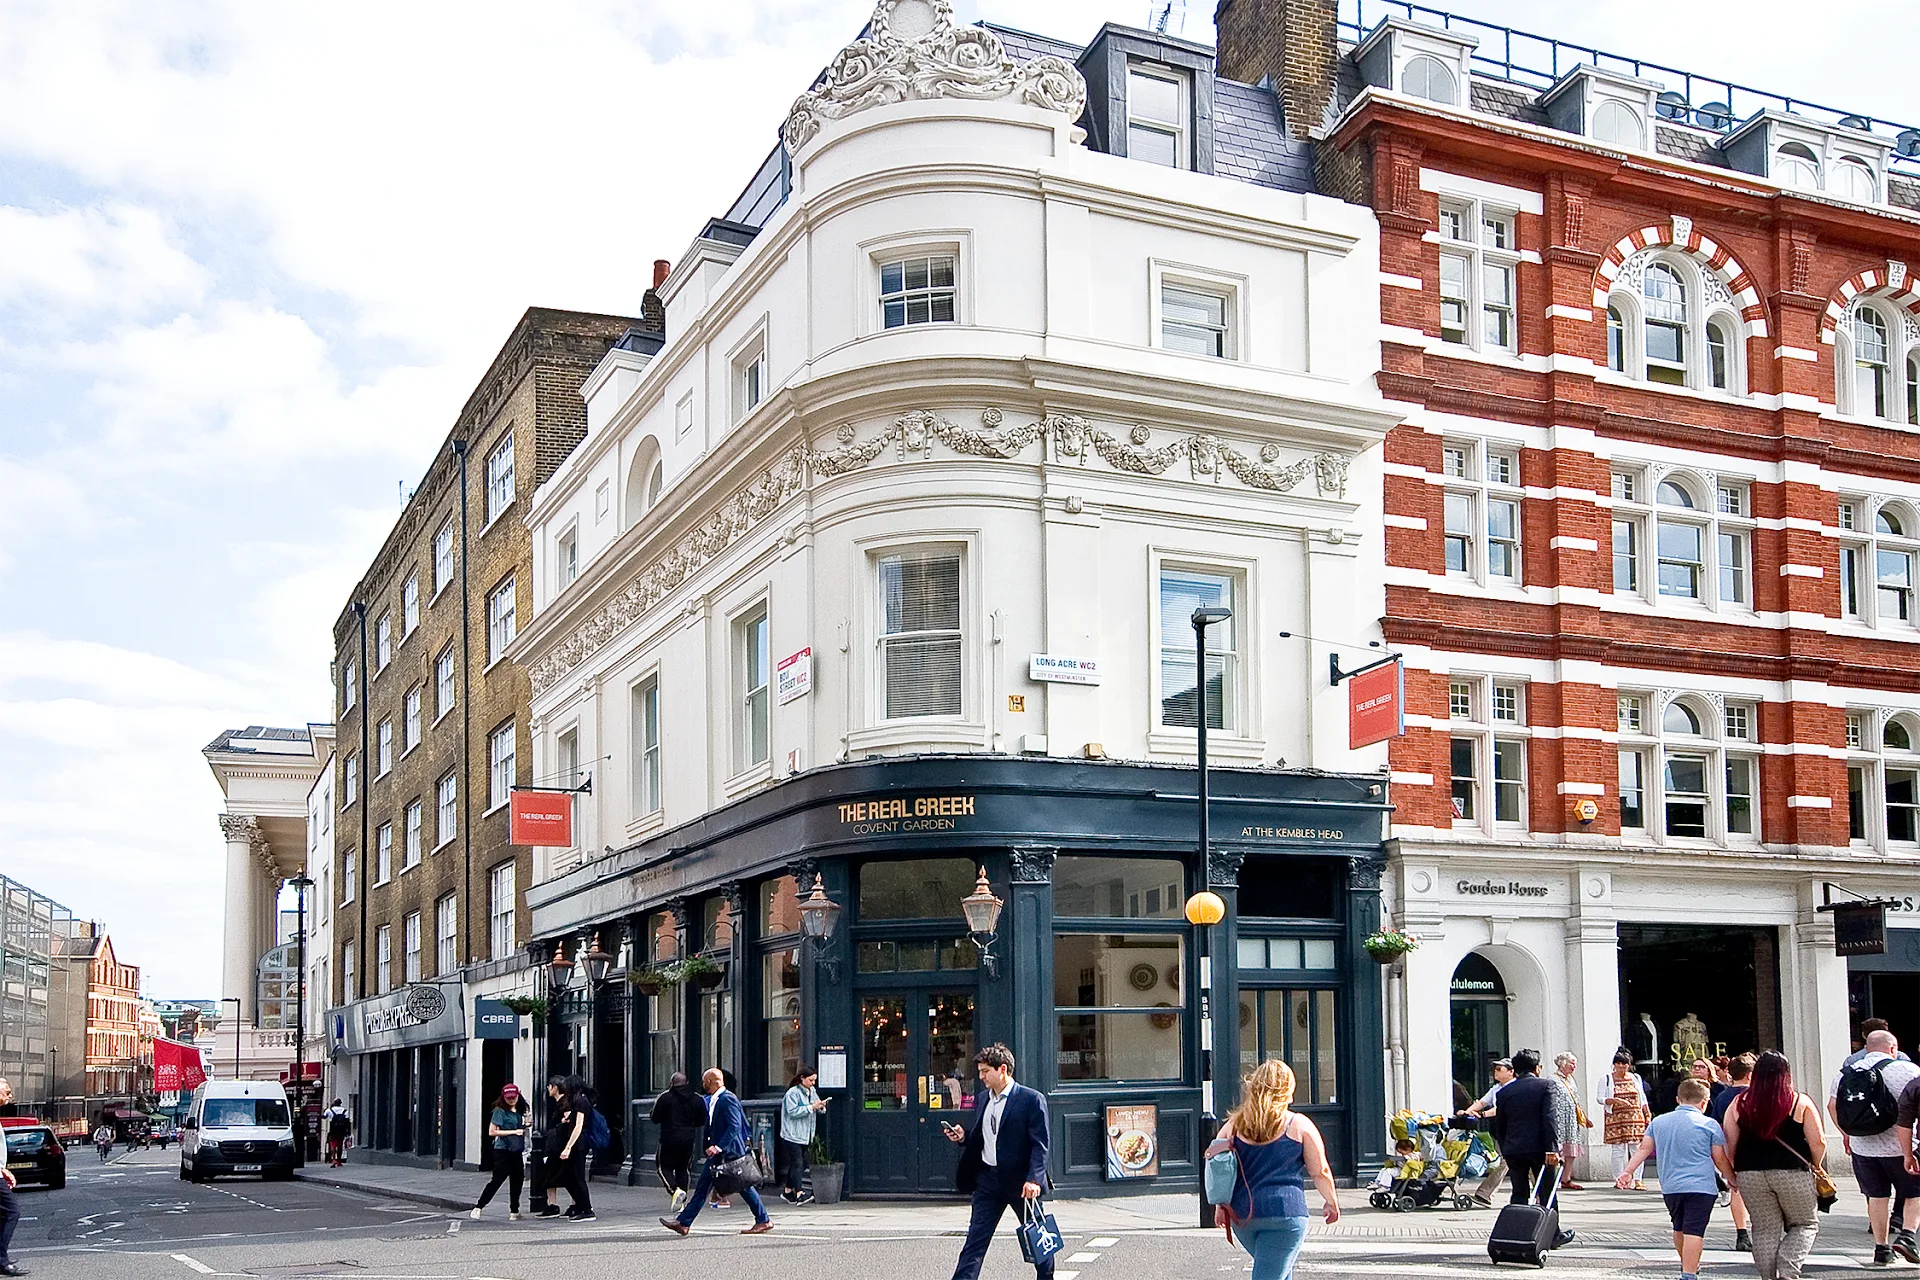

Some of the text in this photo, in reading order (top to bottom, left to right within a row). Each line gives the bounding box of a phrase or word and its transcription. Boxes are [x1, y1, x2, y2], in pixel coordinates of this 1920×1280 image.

[1036, 657, 1096, 670] LONG ACRE WC2
[838, 796, 975, 823] THE REAL GREEK
[852, 818, 956, 835] COVENT GARDEN
[1241, 827, 1343, 840] AT THE KEMBLES HEAD
[1457, 880, 1549, 897] Garden House
[365, 1003, 421, 1035] PIZZAEXPRE
[481, 1014, 514, 1024] CBRE
[1670, 1041, 1727, 1061] SALE
